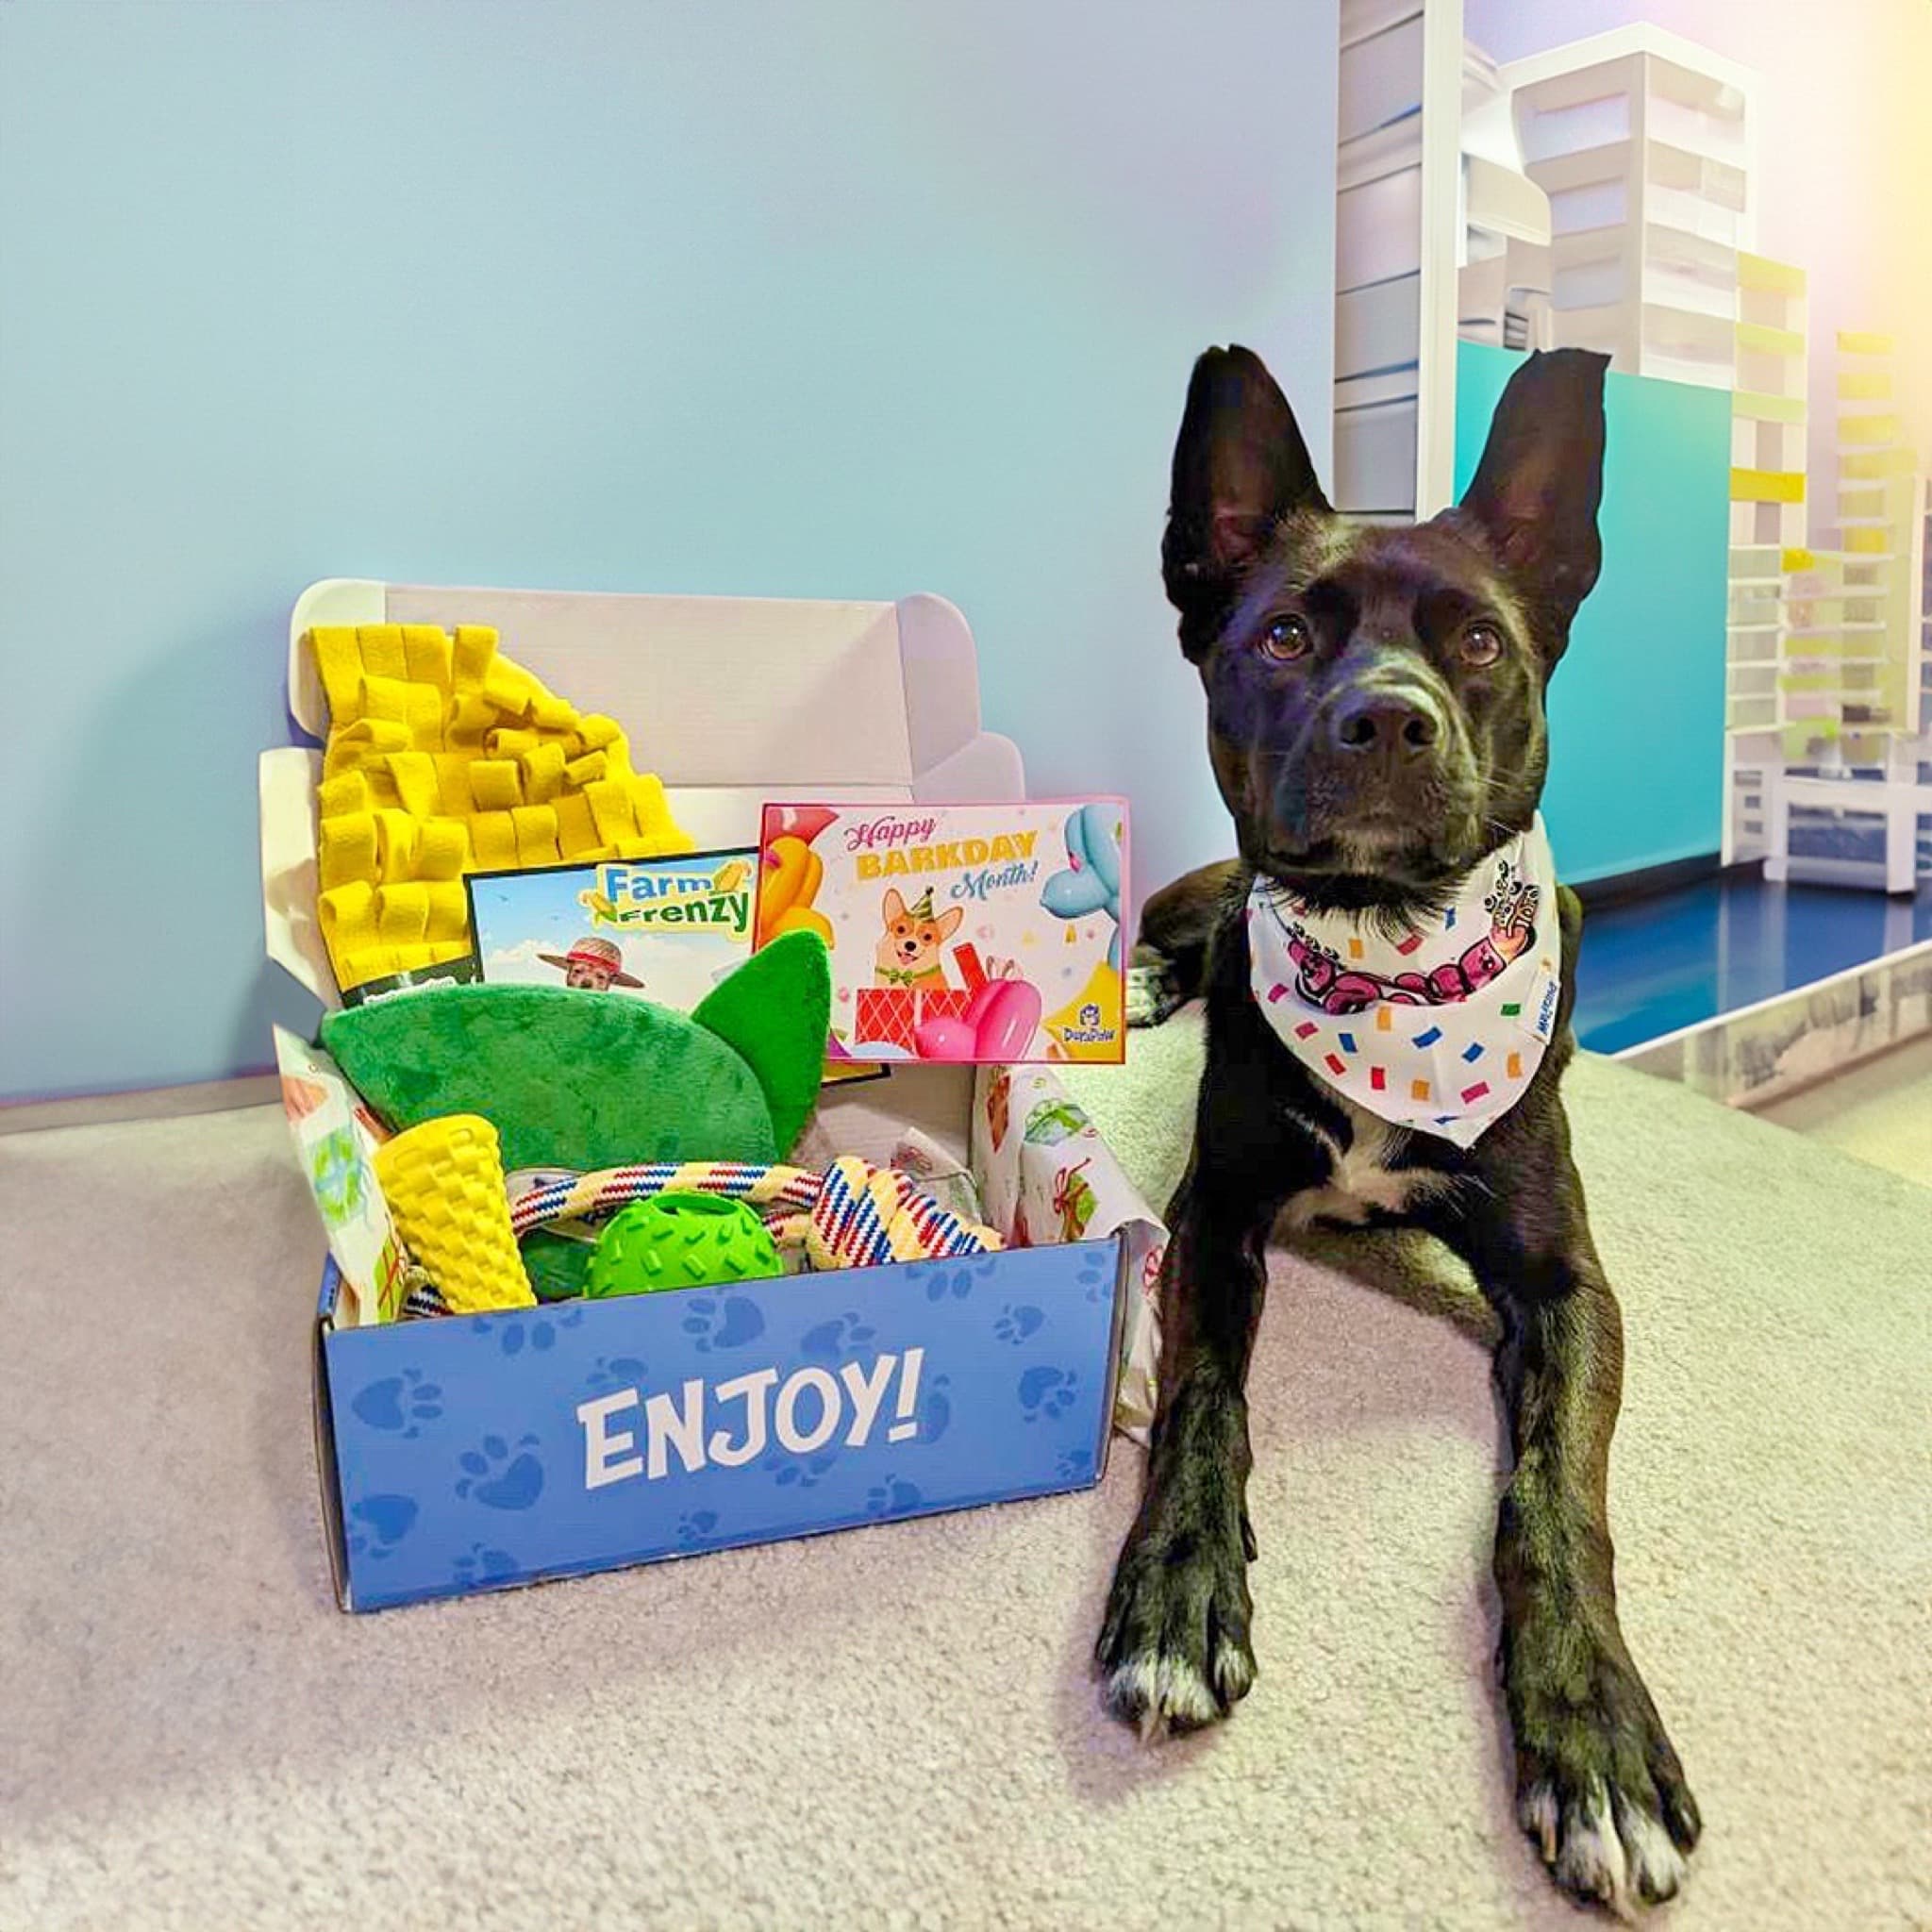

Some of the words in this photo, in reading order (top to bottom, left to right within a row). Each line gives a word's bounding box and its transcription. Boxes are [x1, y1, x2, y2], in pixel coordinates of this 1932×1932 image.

[844, 816, 936, 850] Happy
[857, 830, 1038, 880] BARKDAY
[605, 869, 711, 903] Farm
[951, 860, 1038, 901] Month!
[619, 891, 749, 932] Frenzy
[576, 1348, 924, 1490] ENJOY!
